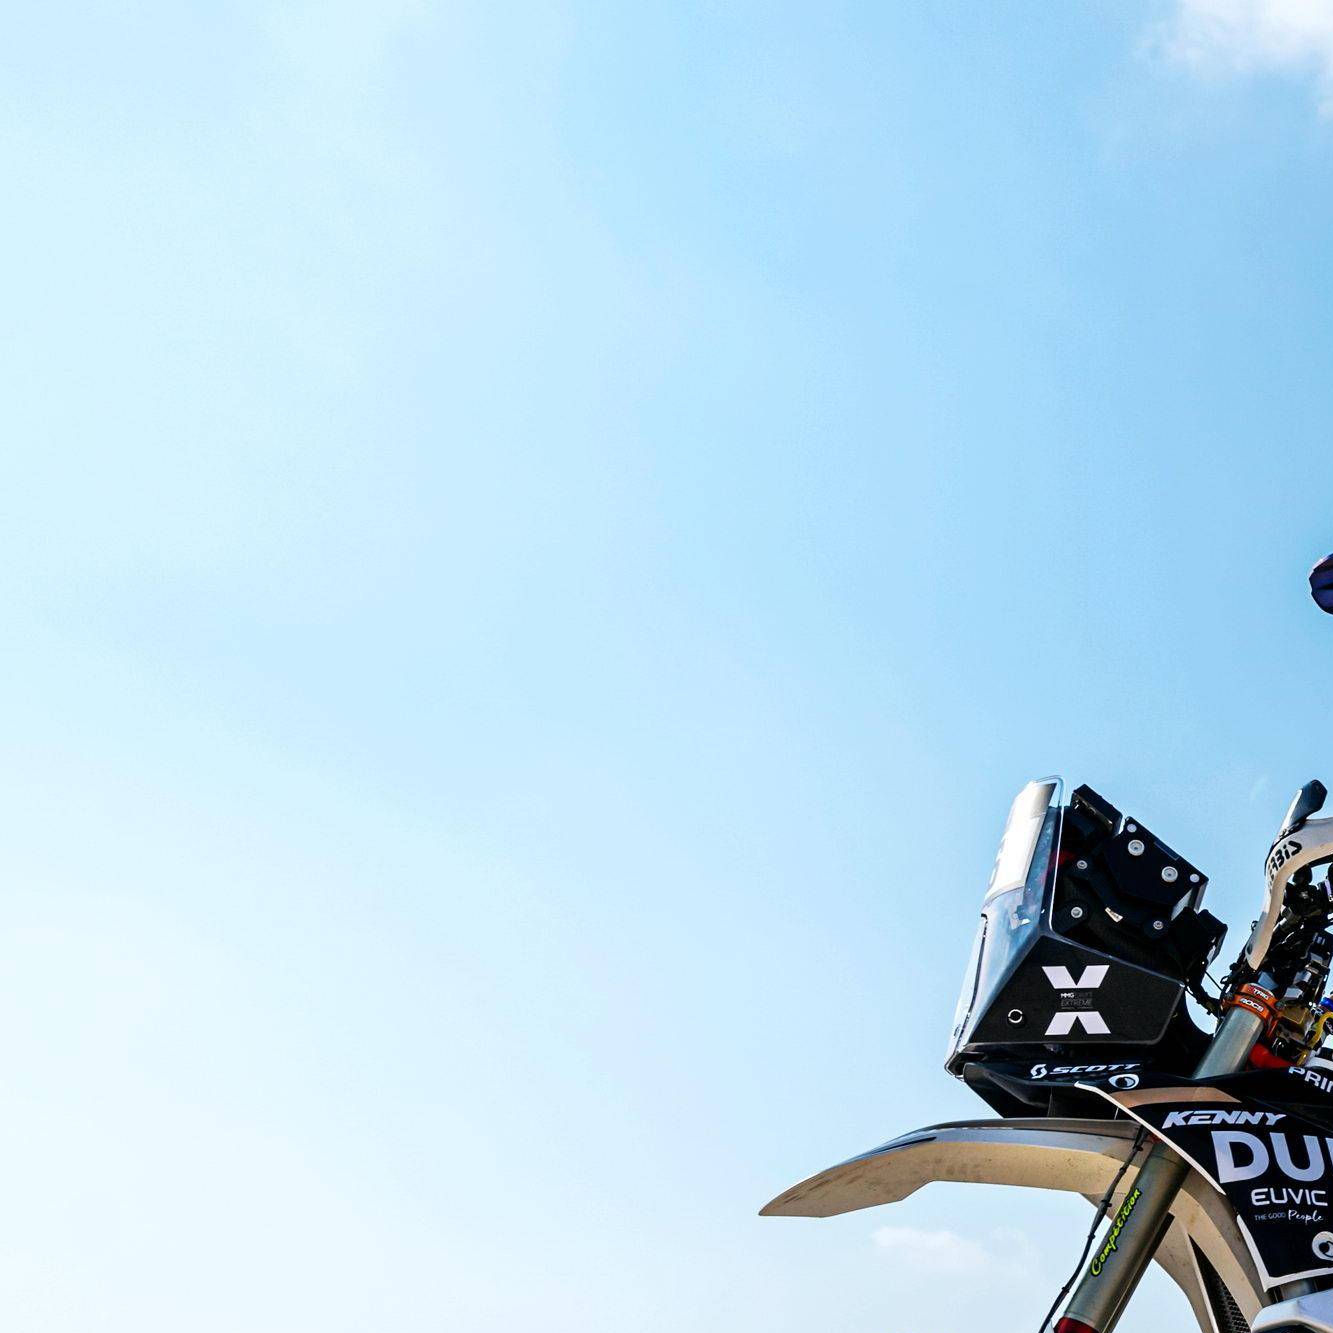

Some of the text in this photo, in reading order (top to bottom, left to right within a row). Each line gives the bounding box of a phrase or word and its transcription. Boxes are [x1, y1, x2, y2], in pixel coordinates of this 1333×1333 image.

[1050, 1063, 1141, 1075] SCOTT
[1161, 1109, 1288, 1129] KENNY
[1250, 1187, 1329, 1207] EUVIC
[1287, 1209, 1325, 1225] People
